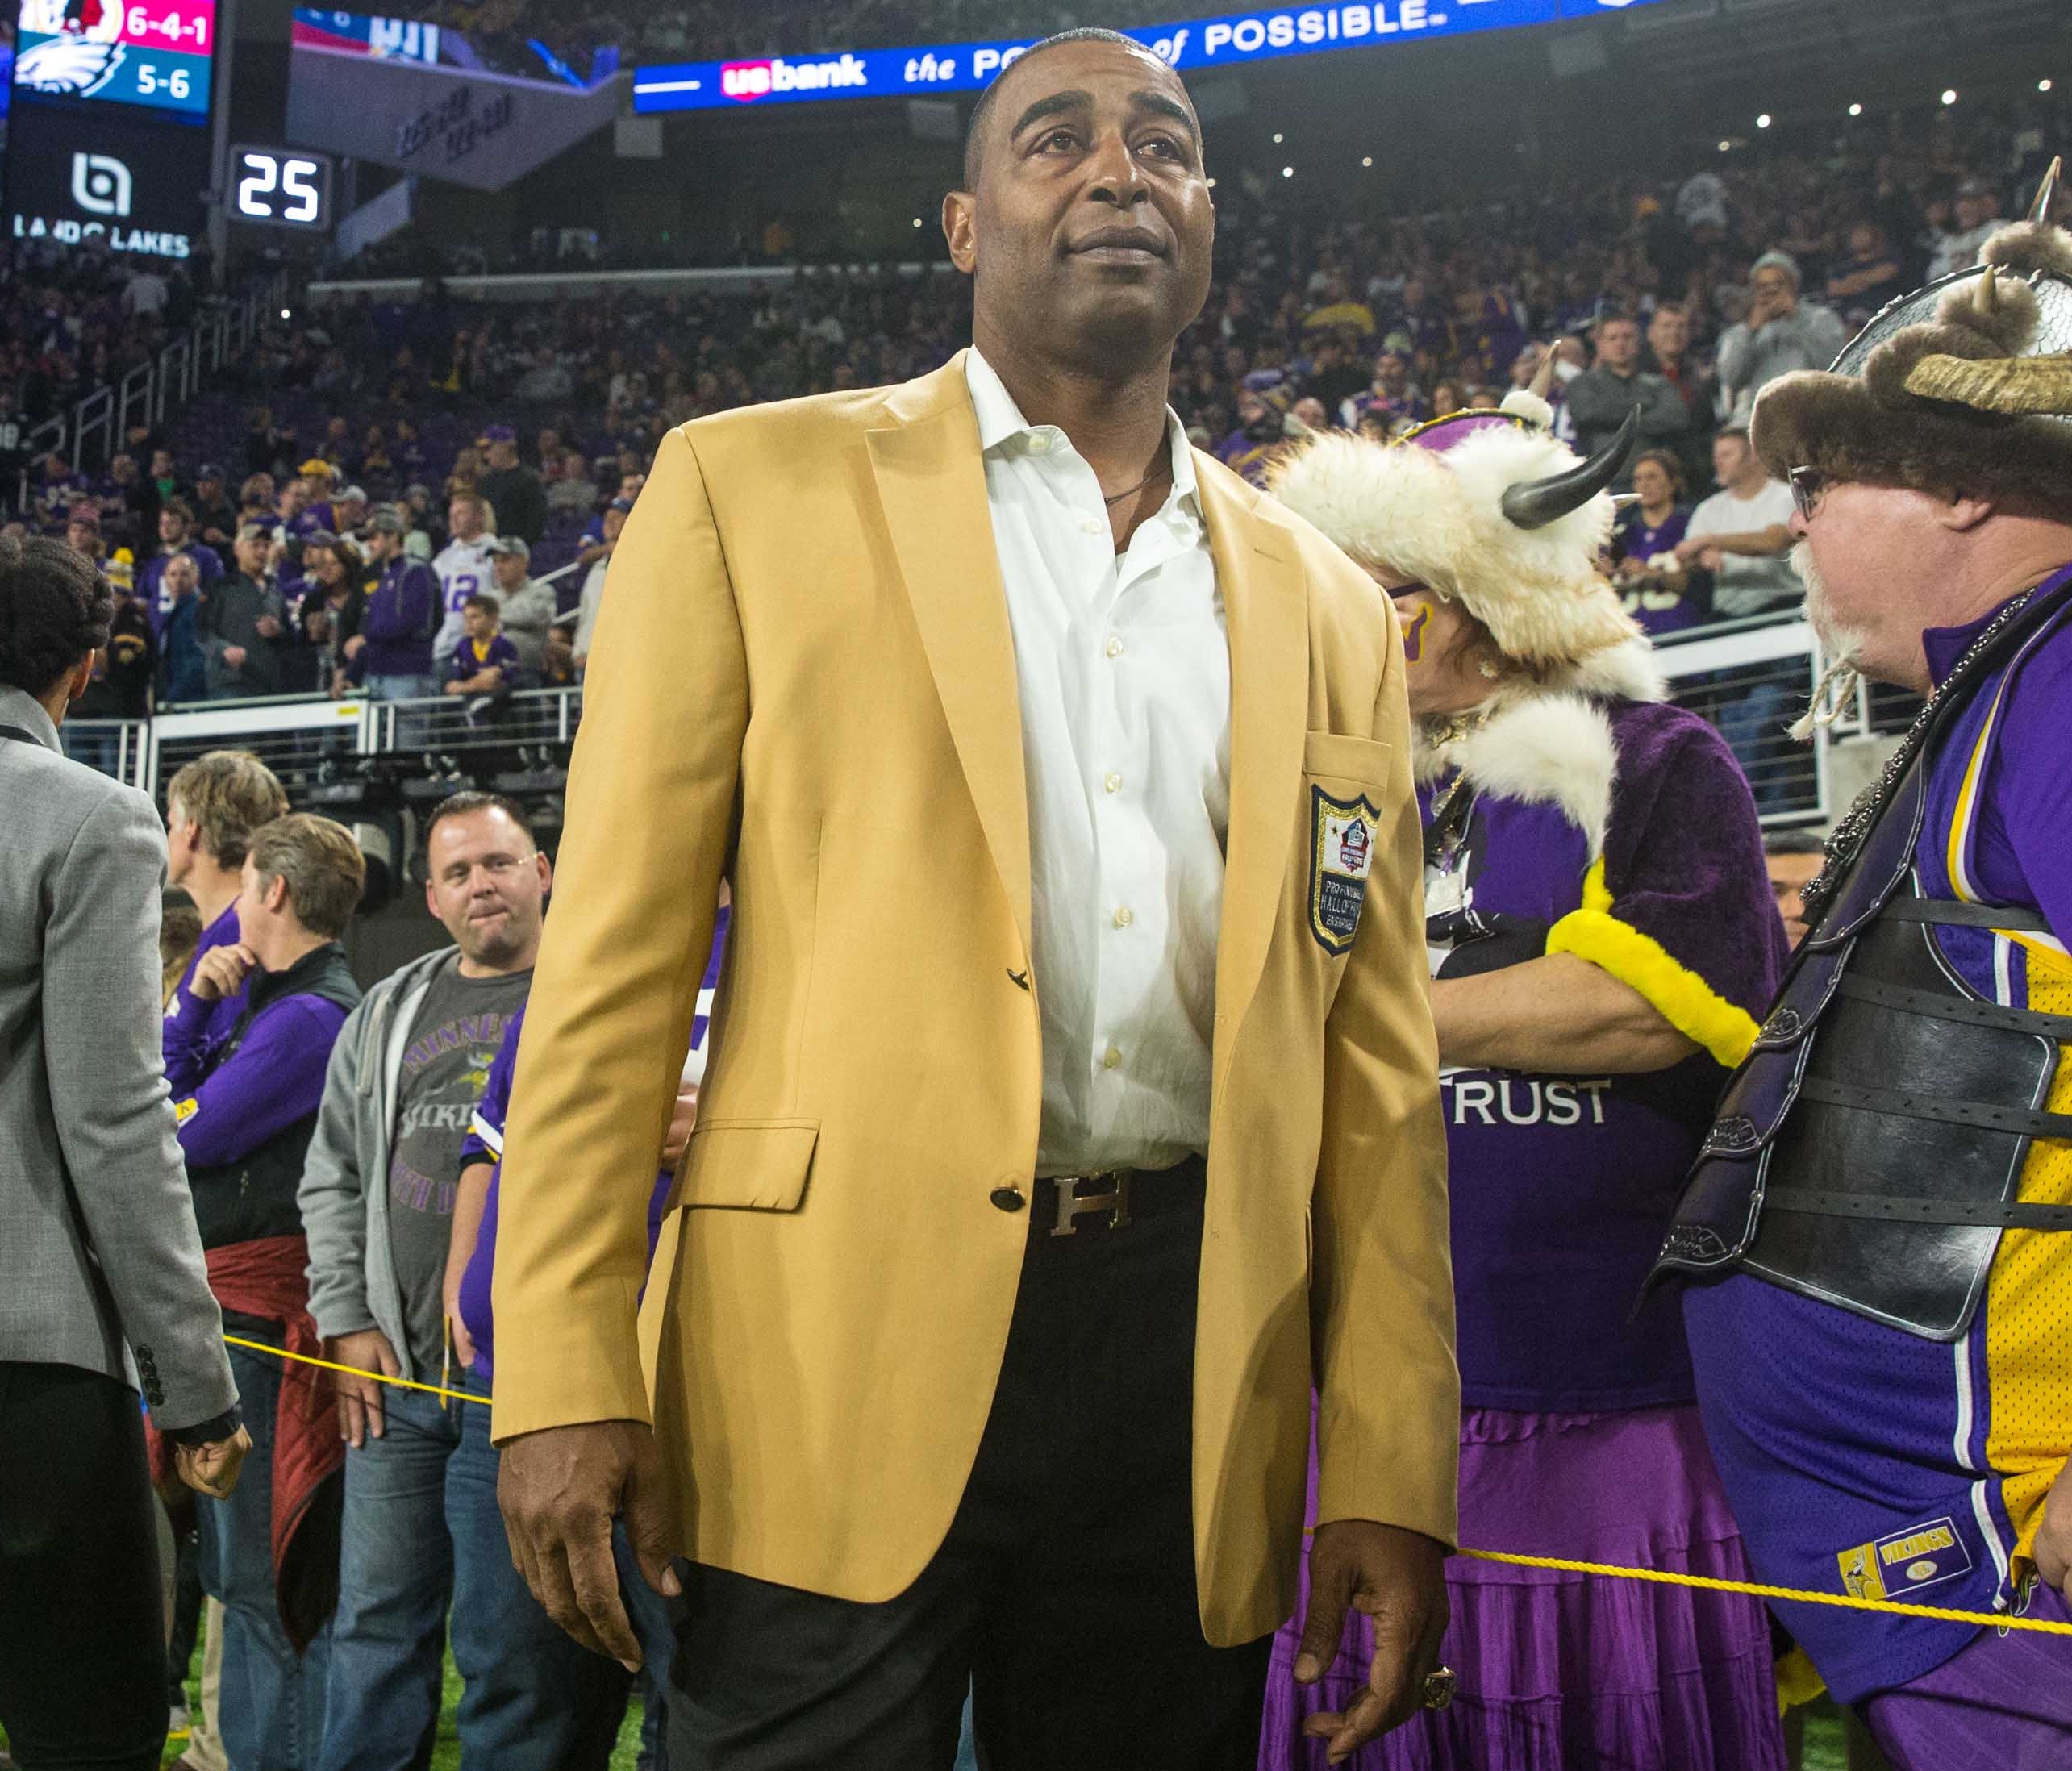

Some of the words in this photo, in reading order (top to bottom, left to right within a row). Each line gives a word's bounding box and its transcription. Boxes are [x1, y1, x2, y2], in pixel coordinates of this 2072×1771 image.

[127, 7, 206, 45] 6-4-1
[904, 52, 957, 83] the
[1153, 29, 1190, 65] of
[137, 65, 190, 98] 5-6
[239, 154, 318, 221] 25
[110, 227, 190, 258] LAKES
[1439, 1075, 1611, 1126] RUST
[399, 1101, 482, 1139] VIKI
[1879, 1526, 1955, 1565] VIKINGS
